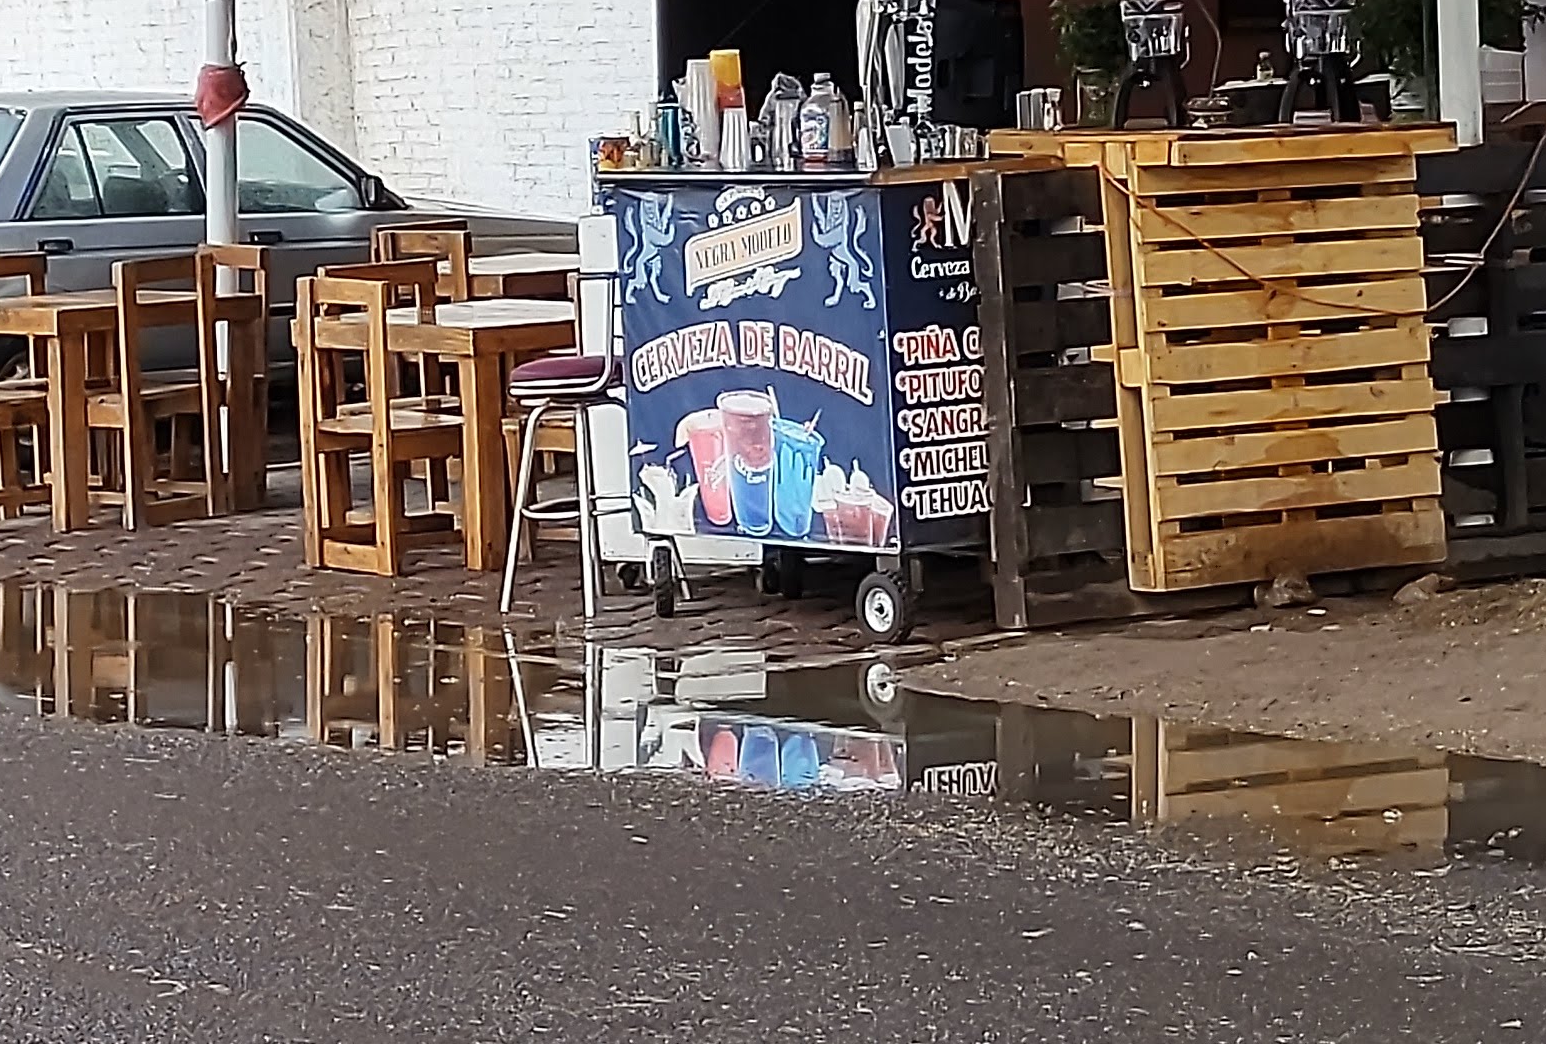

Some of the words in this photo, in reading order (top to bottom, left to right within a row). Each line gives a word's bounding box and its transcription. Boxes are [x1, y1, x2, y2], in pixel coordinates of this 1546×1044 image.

[694, 240, 736, 270] NEGRA
[741, 221, 792, 257] MODELO
[910, 256, 971, 279] Cerveza
[632, 321, 737, 393] CERVEZA
[739, 320, 775, 368] DE
[779, 325, 874, 406] BARRIL
[908, 404, 990, 442] SANGR
[910, 441, 990, 481] MICHEL
[914, 480, 994, 519] TEHUA
